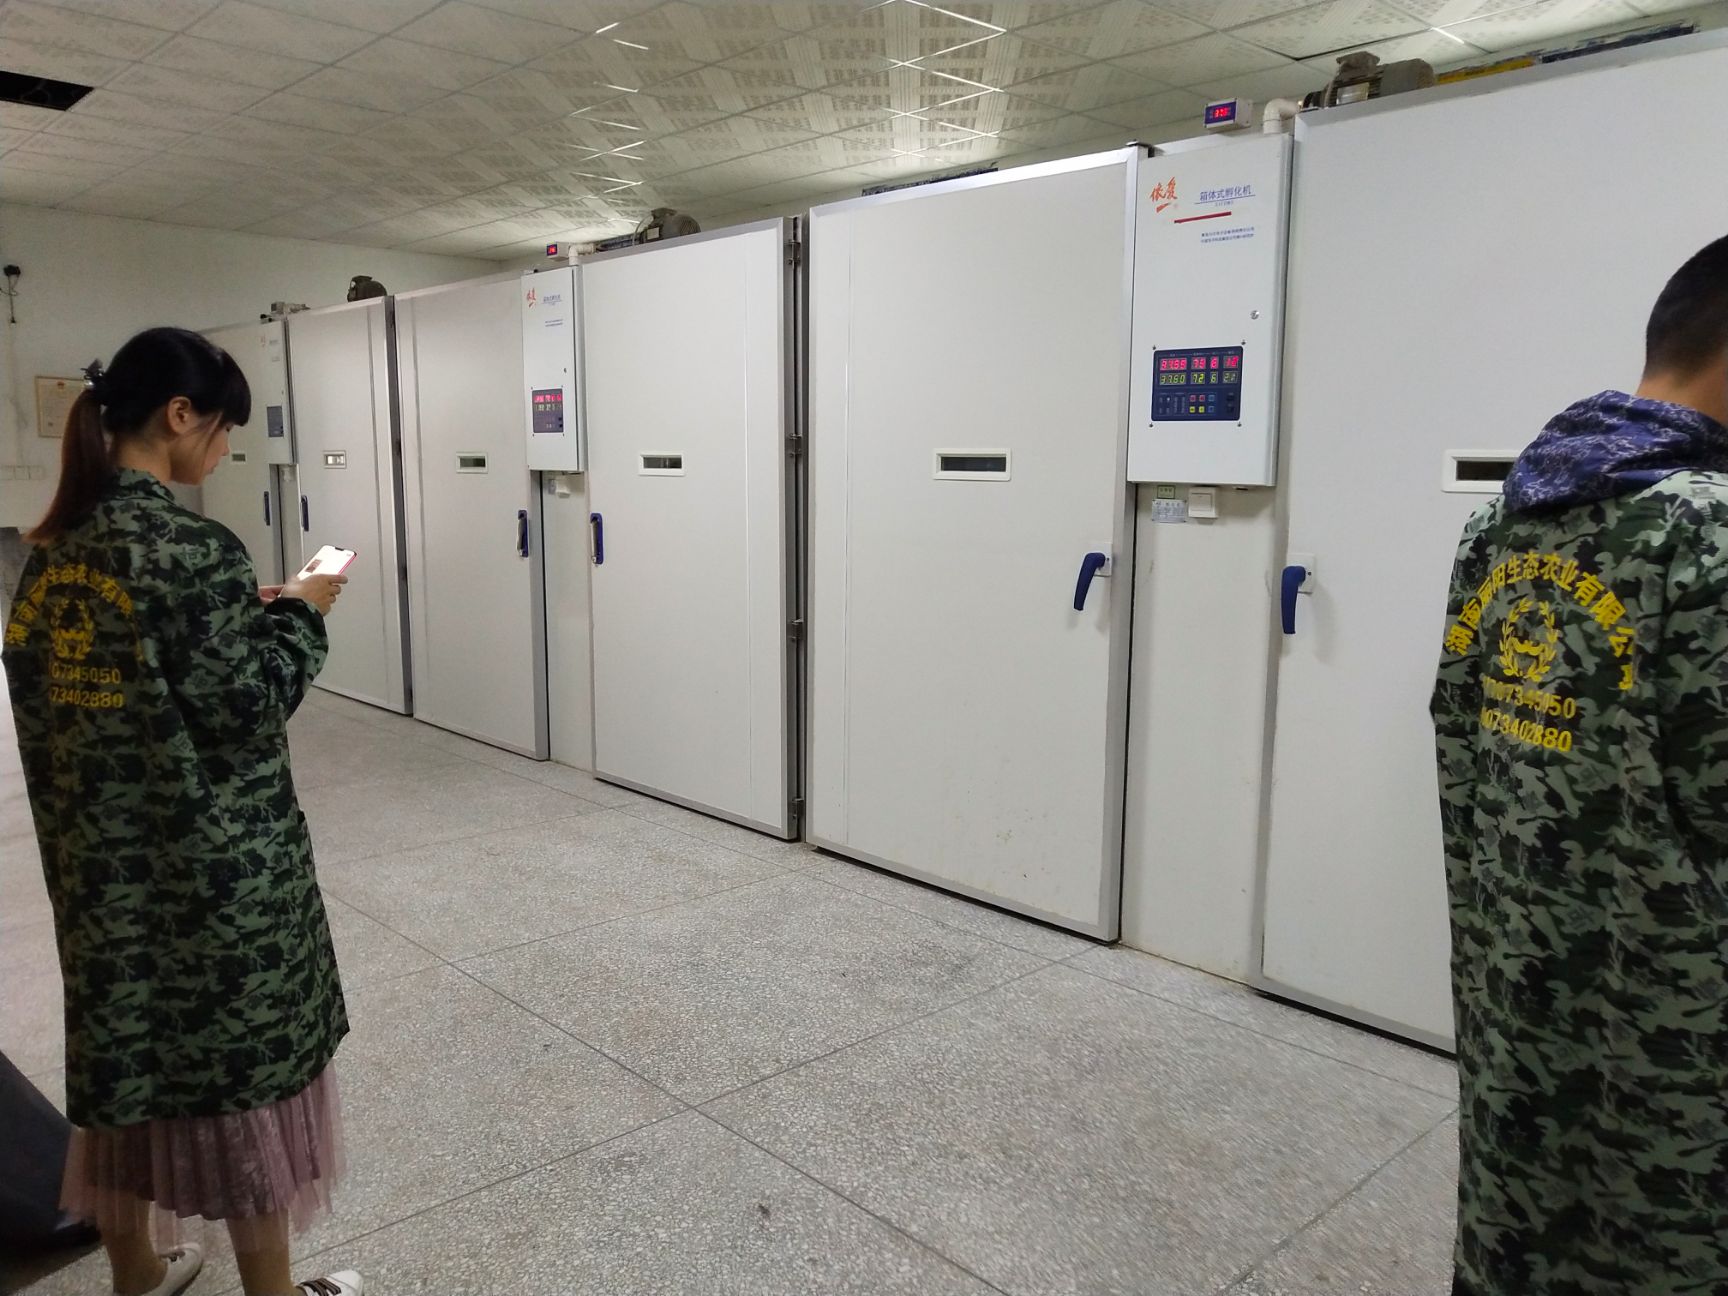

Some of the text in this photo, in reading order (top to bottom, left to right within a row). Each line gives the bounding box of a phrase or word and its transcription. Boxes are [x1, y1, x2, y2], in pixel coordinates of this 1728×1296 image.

[1200, 185, 1252, 202] 箱体式孵化机
